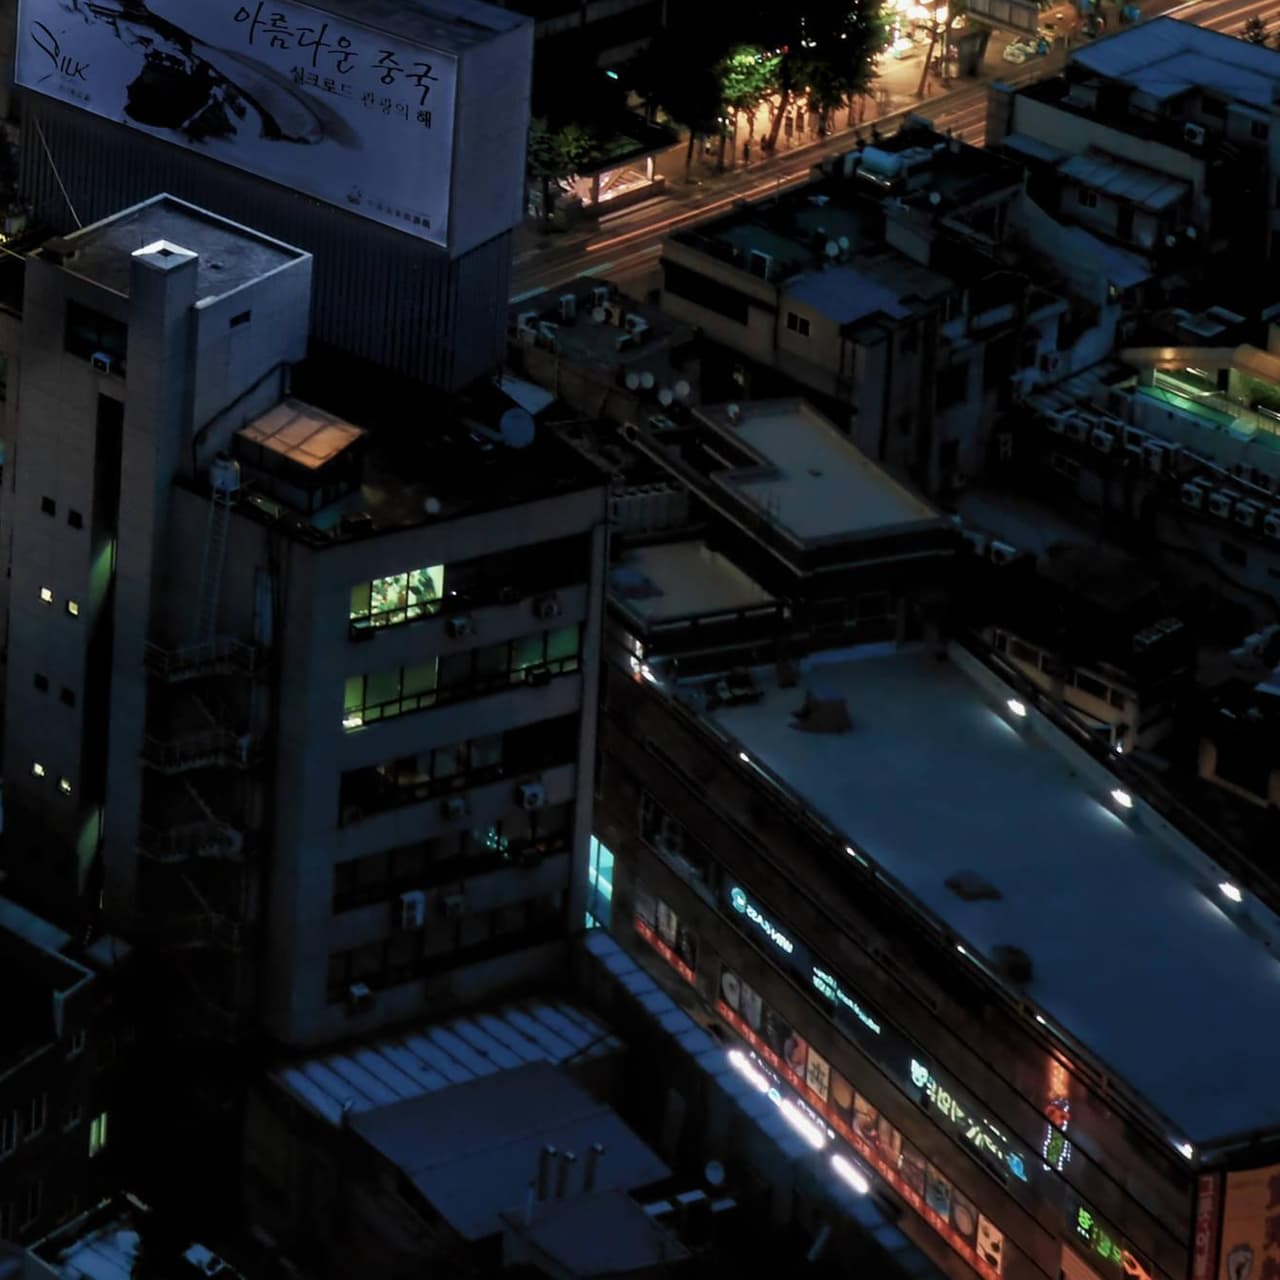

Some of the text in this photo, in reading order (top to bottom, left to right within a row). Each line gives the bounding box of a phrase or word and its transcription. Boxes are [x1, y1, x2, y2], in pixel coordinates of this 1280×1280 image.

[31, 20, 90, 81] SILK
[233, 1, 439, 106] 아름다운 중국
[290, 64, 354, 96] 실크로드
[416, 110, 432, 129] 해
